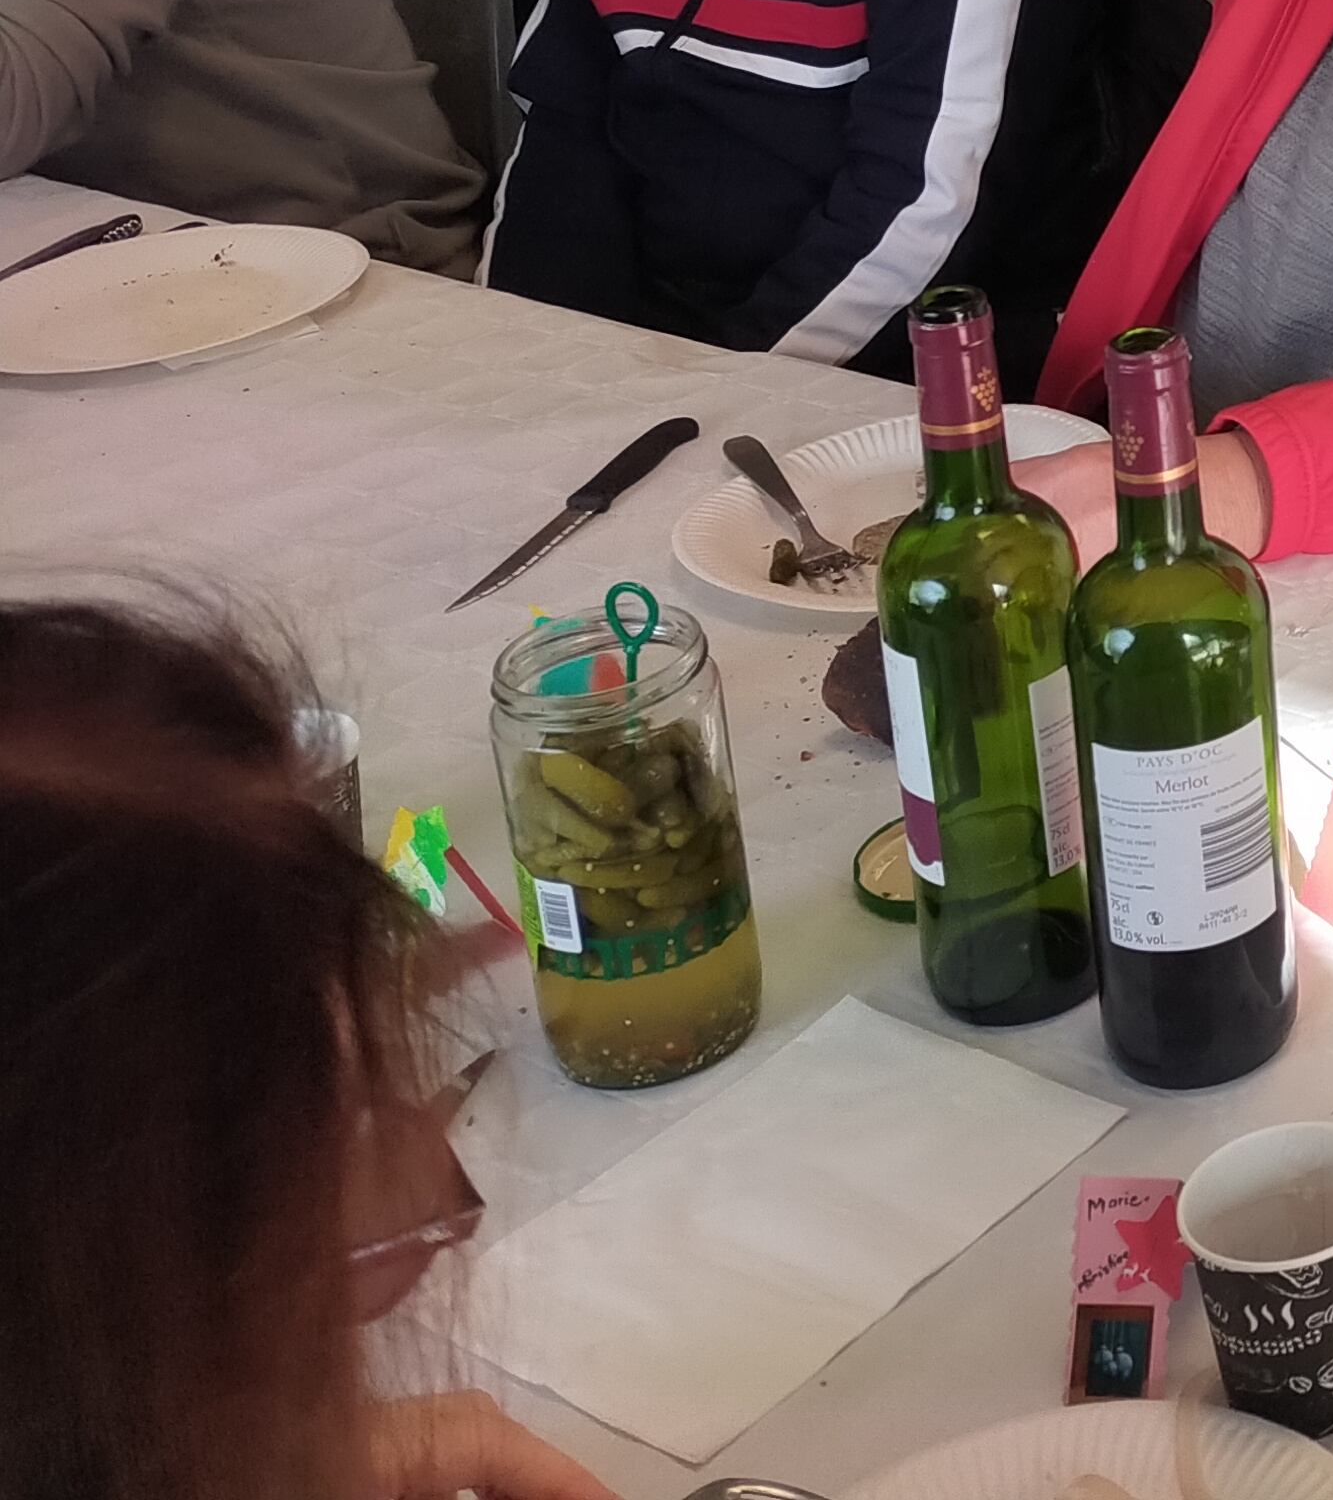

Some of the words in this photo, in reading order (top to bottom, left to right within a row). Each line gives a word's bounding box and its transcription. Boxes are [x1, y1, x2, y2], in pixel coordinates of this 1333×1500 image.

[1136, 755, 1174, 769] PAYS
[1180, 743, 1223, 765] D'OC
[1155, 775, 1209, 794] Merlot
